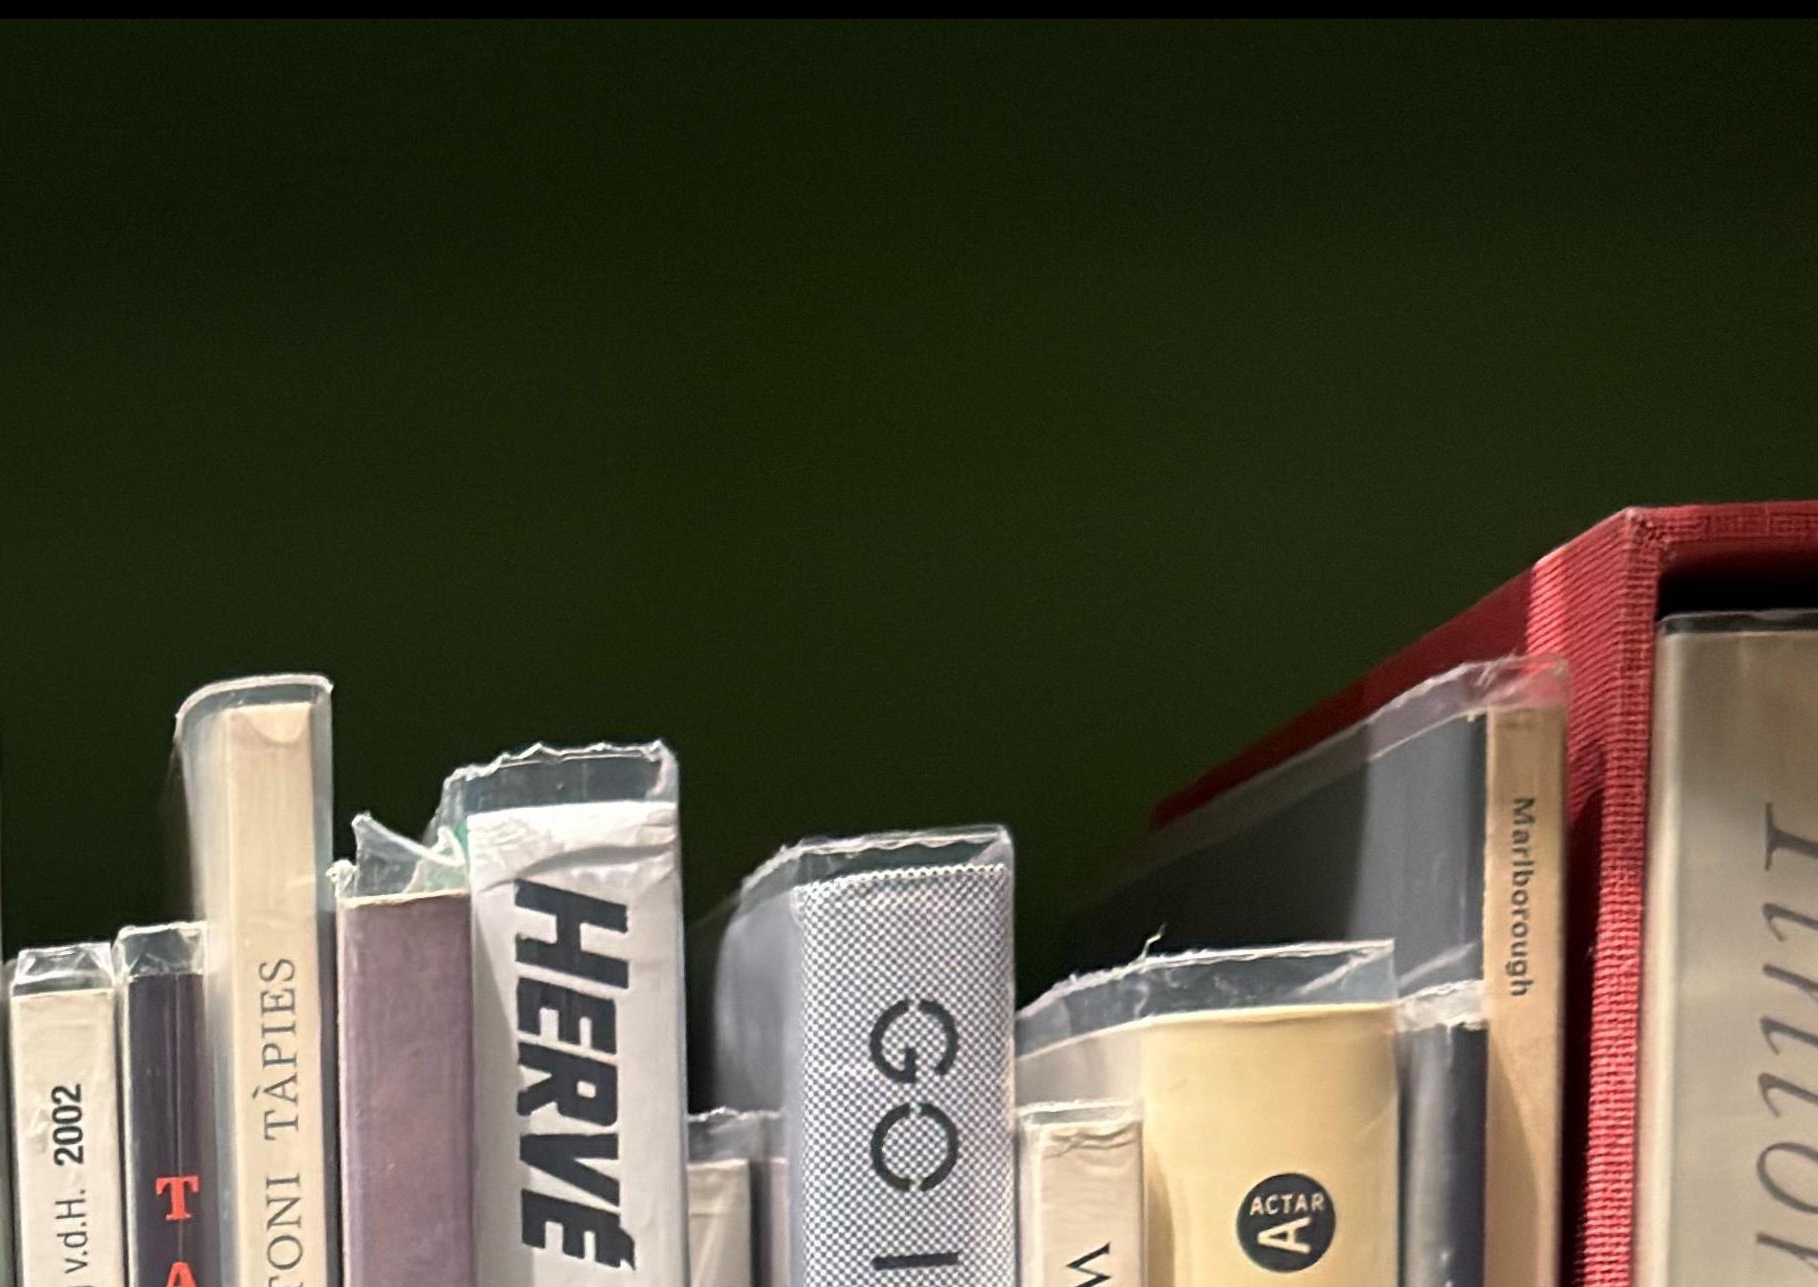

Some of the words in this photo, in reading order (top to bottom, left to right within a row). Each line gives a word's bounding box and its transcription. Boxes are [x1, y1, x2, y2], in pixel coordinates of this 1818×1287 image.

[1504, 796, 1537, 998] Marlborough
[52, 1082, 86, 1168] 2002
[251, 957, 300, 1141] TÀPIES
[513, 877, 637, 1272] HERVÉ
[868, 998, 961, 1194] GO
[56, 1186, 88, 1265] v.d.H.
[1249, 1193, 1324, 1216] ACTAR
